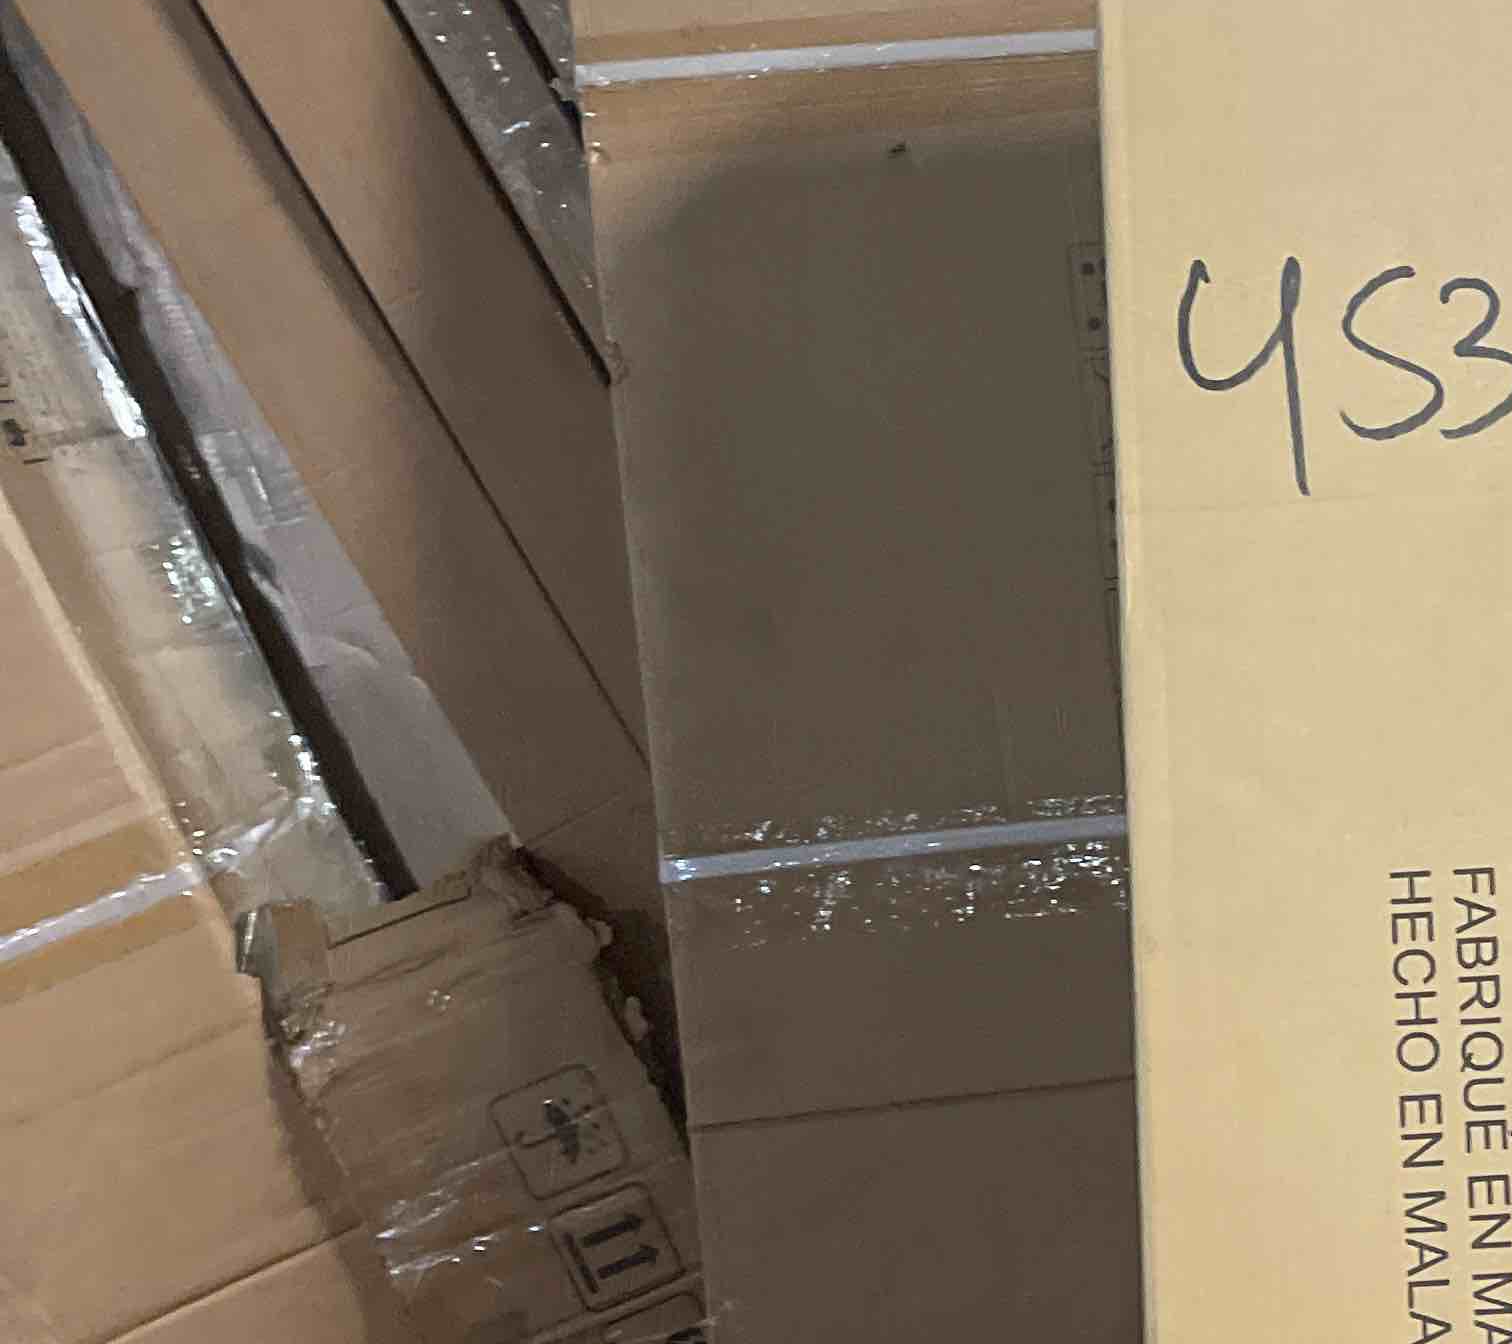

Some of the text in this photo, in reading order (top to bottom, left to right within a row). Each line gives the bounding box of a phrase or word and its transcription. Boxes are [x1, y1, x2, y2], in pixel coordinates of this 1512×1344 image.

[1389, 870, 1440, 1072] HECHO
[1399, 1094, 1444, 1168] EN
[1467, 1174, 1512, 1249] EN
